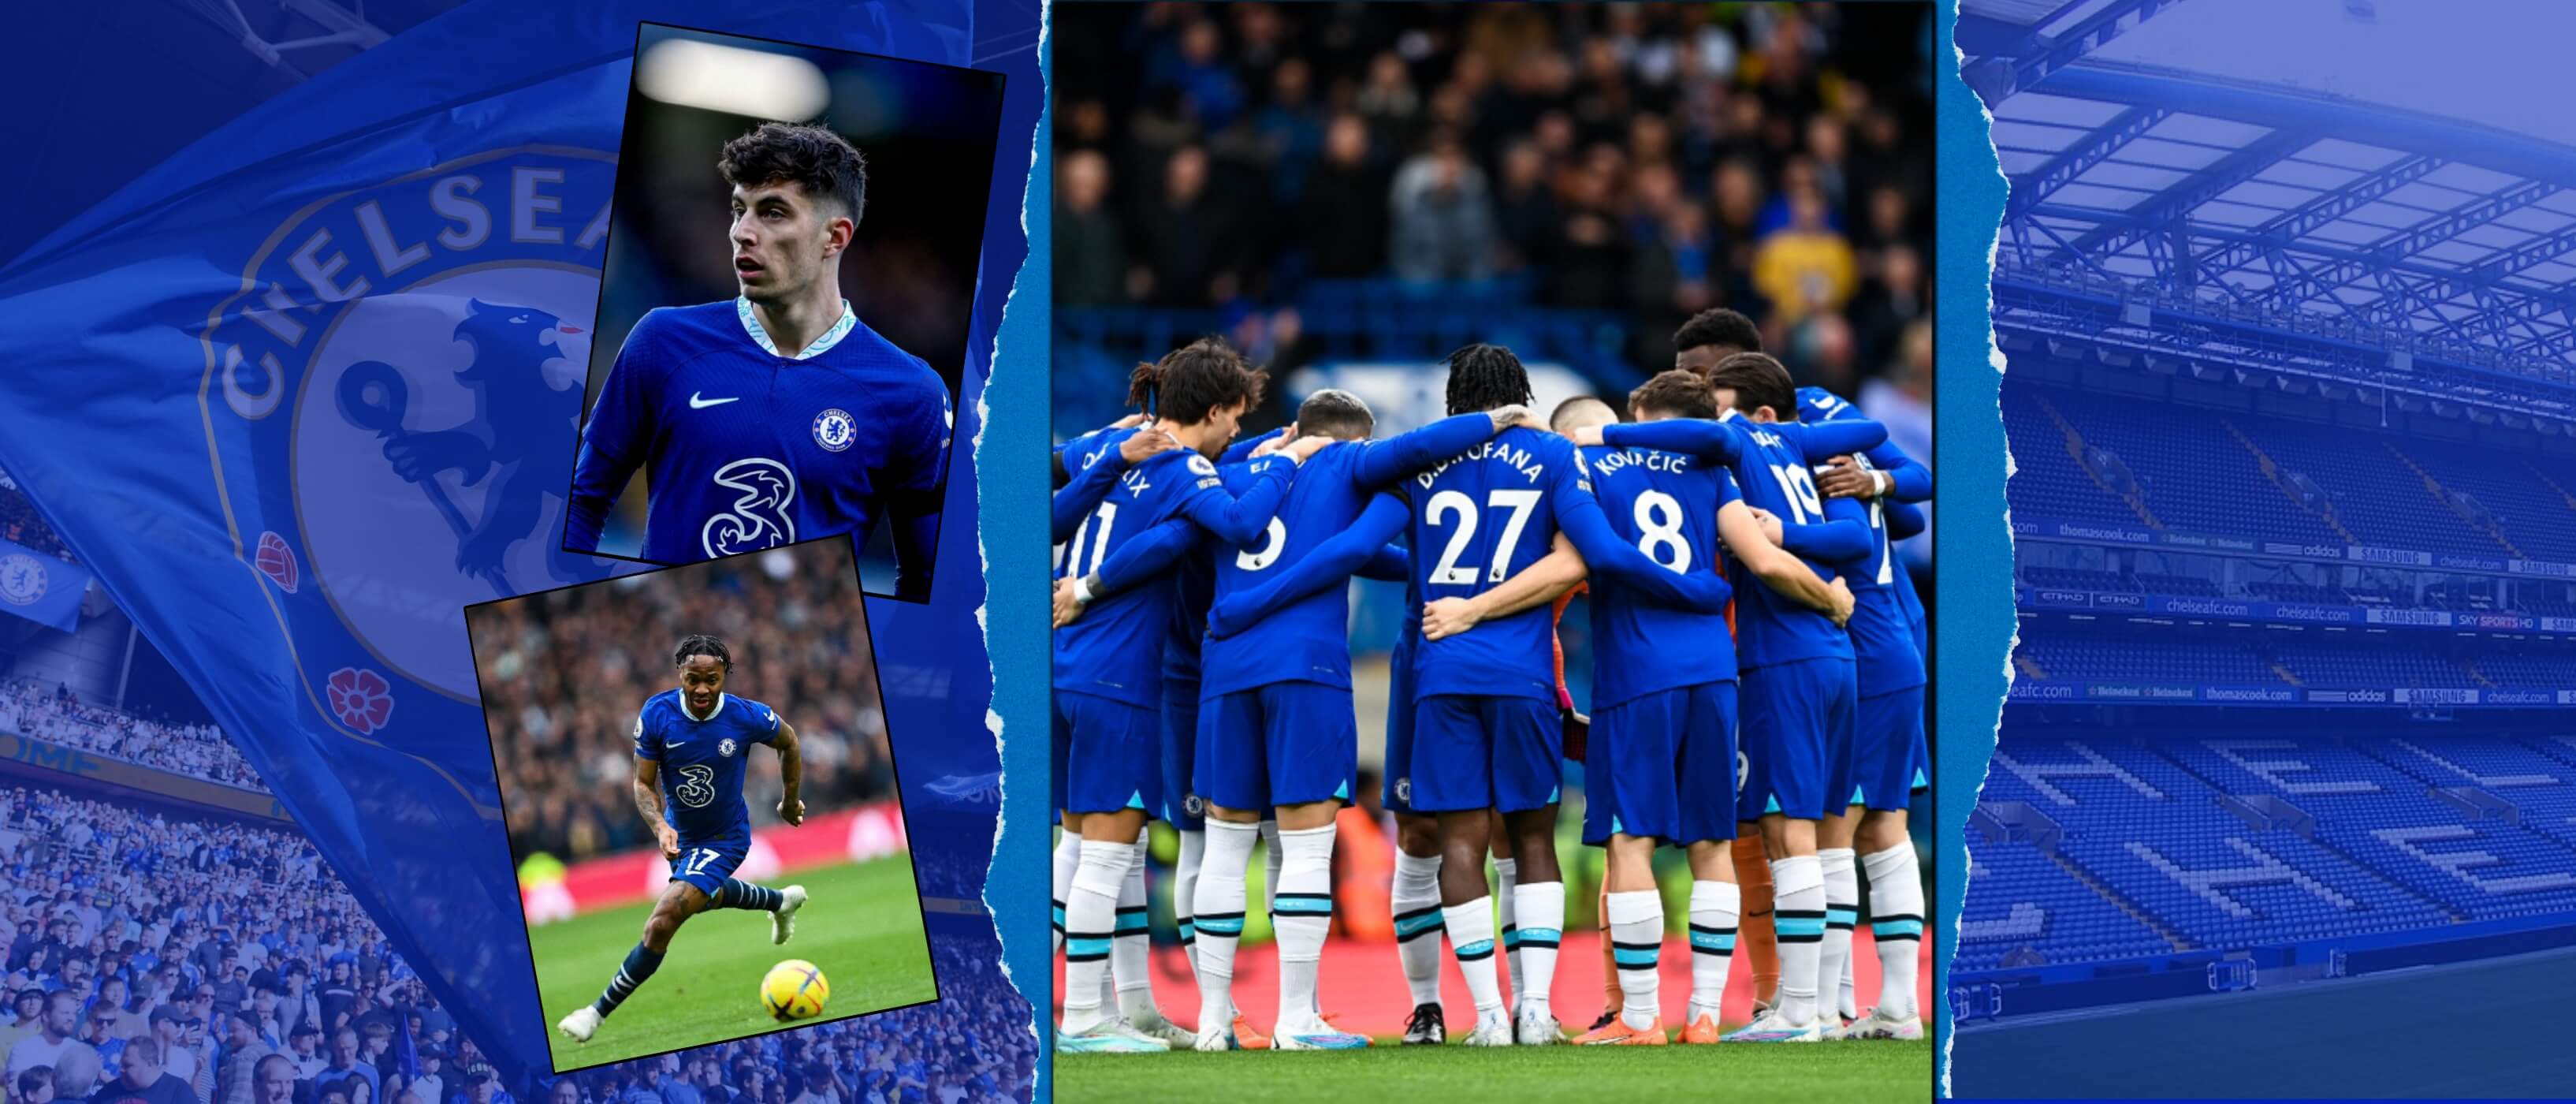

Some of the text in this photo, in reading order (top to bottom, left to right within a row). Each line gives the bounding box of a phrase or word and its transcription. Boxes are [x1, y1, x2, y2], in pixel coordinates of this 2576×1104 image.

[1594, 450, 1687, 476] KOVAČIĆ
[1425, 490, 1543, 584] 27
[1634, 489, 1692, 575] 8
[2059, 524, 2150, 543] thomascook.com
[2304, 544, 2340, 558] adidas
[2361, 548, 2420, 563] SAMSUNG
[2042, 592, 2084, 602] ETIHAD
[2099, 595, 2139, 605] ETIHAD
[2167, 599, 2248, 616] chelseafc.com
[2276, 605, 2350, 621] chelseafc.com
[2381, 610, 2440, 625] SAMSUNG
[2459, 614, 2533, 628] SKY SPORTS HD
[2098, 686, 2140, 697] Heineken
[2153, 688, 2193, 698] Heineken
[2206, 687, 2292, 701] thomascook.com
[2347, 689, 2387, 702] adidas
[2408, 689, 2466, 703] SAMSUNG
[2487, 690, 2550, 704] chelseafc.com
[676, 764, 715, 808] 3
[686, 847, 721, 871] 17
